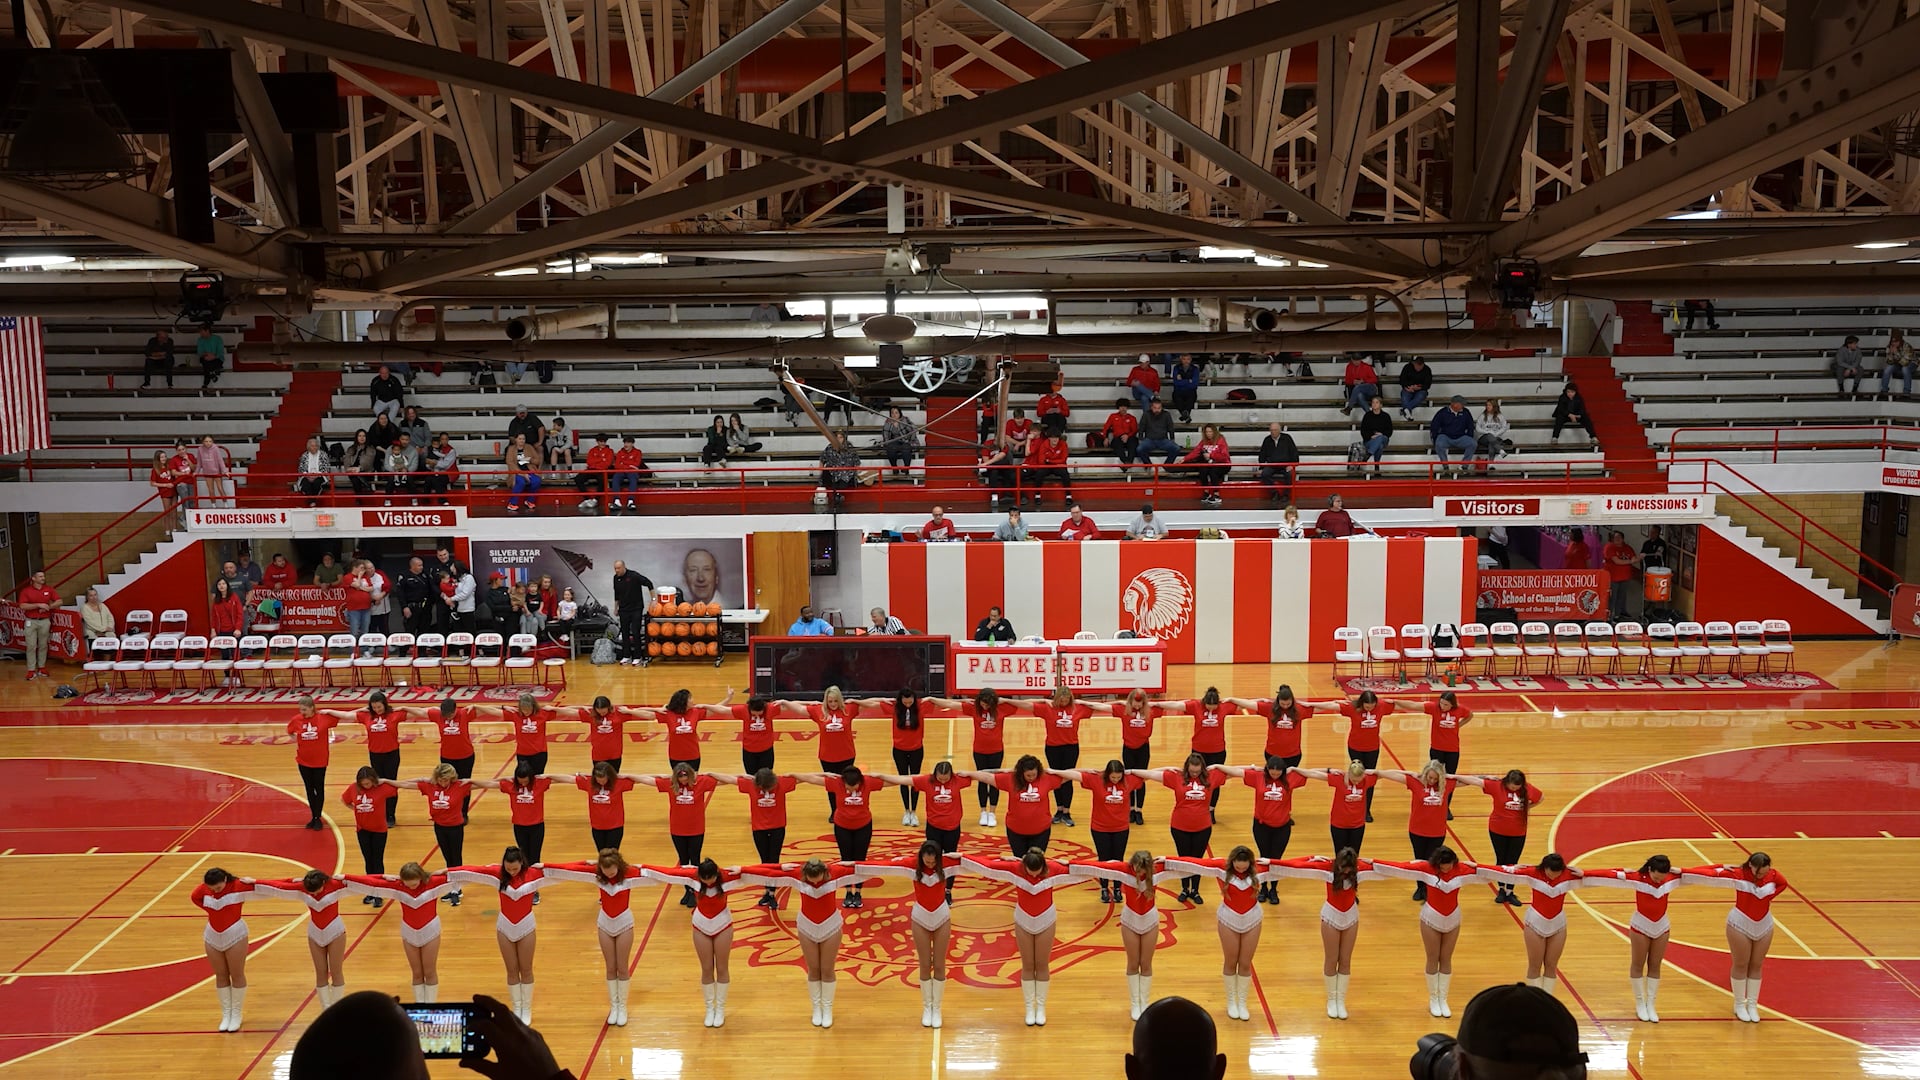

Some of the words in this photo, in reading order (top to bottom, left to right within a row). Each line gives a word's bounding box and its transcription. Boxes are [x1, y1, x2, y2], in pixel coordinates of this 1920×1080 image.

[1884, 476, 1907, 484] STUDENT
[1896, 469, 1918, 478] VISITOR
[1461, 501, 1524, 514] Visitors
[1616, 499, 1688, 510] CONCESSIONS
[205, 513, 276, 524] CONCESSIONS
[377, 512, 441, 525] Visitors
[489, 549, 518, 557] SILVER
[519, 549, 540, 557] STAR
[492, 556, 535, 564] RECIPIENT
[1481, 575, 1540, 589] PARKERSBURG
[1541, 575, 1563, 588] HIGH
[1565, 574, 1598, 588] SCHOOL
[301, 588, 322, 601] HIGH
[323, 588, 347, 600] SCHO
[1501, 590, 1526, 605] School
[1527, 594, 1535, 603] of
[1535, 592, 1576, 605] Champions
[288, 606, 296, 616] of
[296, 604, 337, 618] Champions
[1543, 606, 1554, 614] Big
[968, 656, 1150, 673] PARKERSBURG
[1026, 676, 1046, 687] BIG
[1561, 674, 1747, 690] REDS
[154, 685, 483, 704] PARKERSBURG
